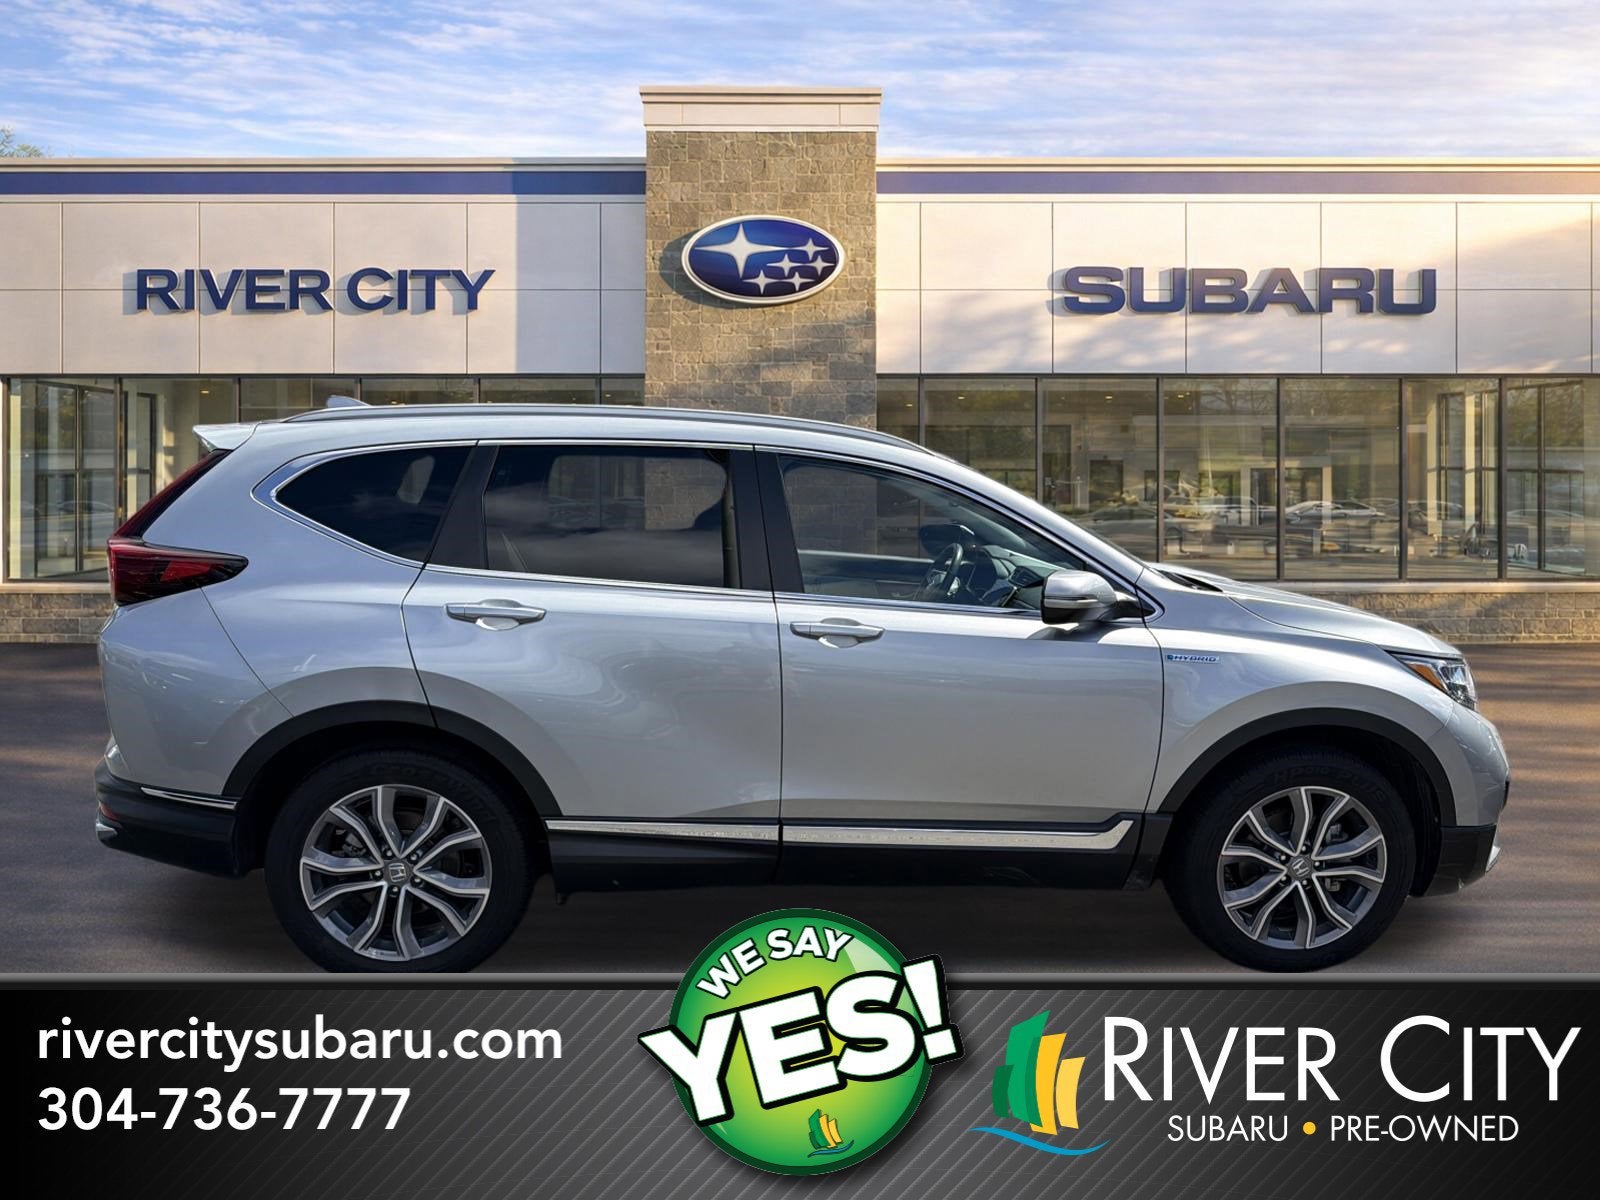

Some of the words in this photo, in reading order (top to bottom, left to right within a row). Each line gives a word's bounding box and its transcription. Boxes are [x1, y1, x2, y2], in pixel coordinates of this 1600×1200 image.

[136, 268, 332, 311] RIVER
[347, 267, 495, 311] CITY
[1063, 266, 1437, 314] SUBARU
